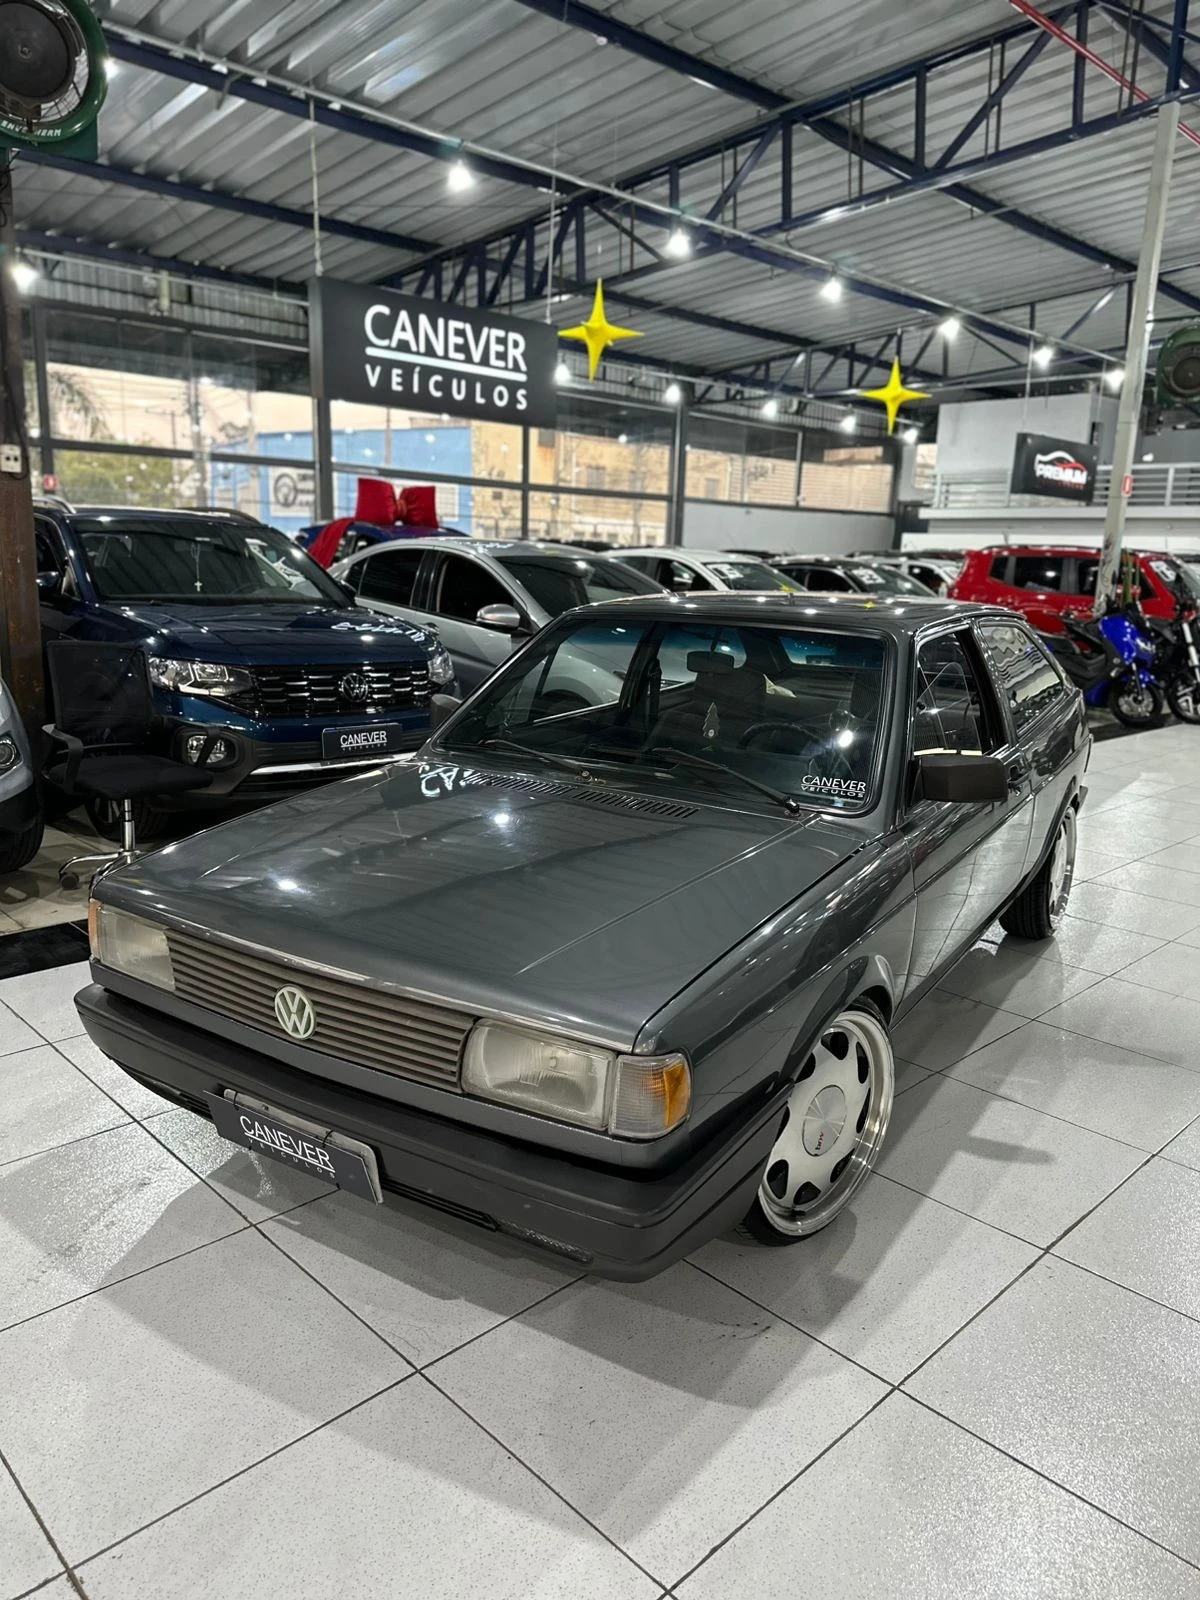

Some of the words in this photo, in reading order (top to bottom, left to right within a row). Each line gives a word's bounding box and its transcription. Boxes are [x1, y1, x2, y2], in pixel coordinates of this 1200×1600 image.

[364, 304, 528, 372] CANEVER
[365, 363, 528, 411] VEÍCULOS
[1036, 463, 1088, 485] PREMIUM
[340, 731, 387, 746] CANEVER
[802, 775, 866, 792] CANEVER
[240, 1115, 335, 1171] CANEVER
